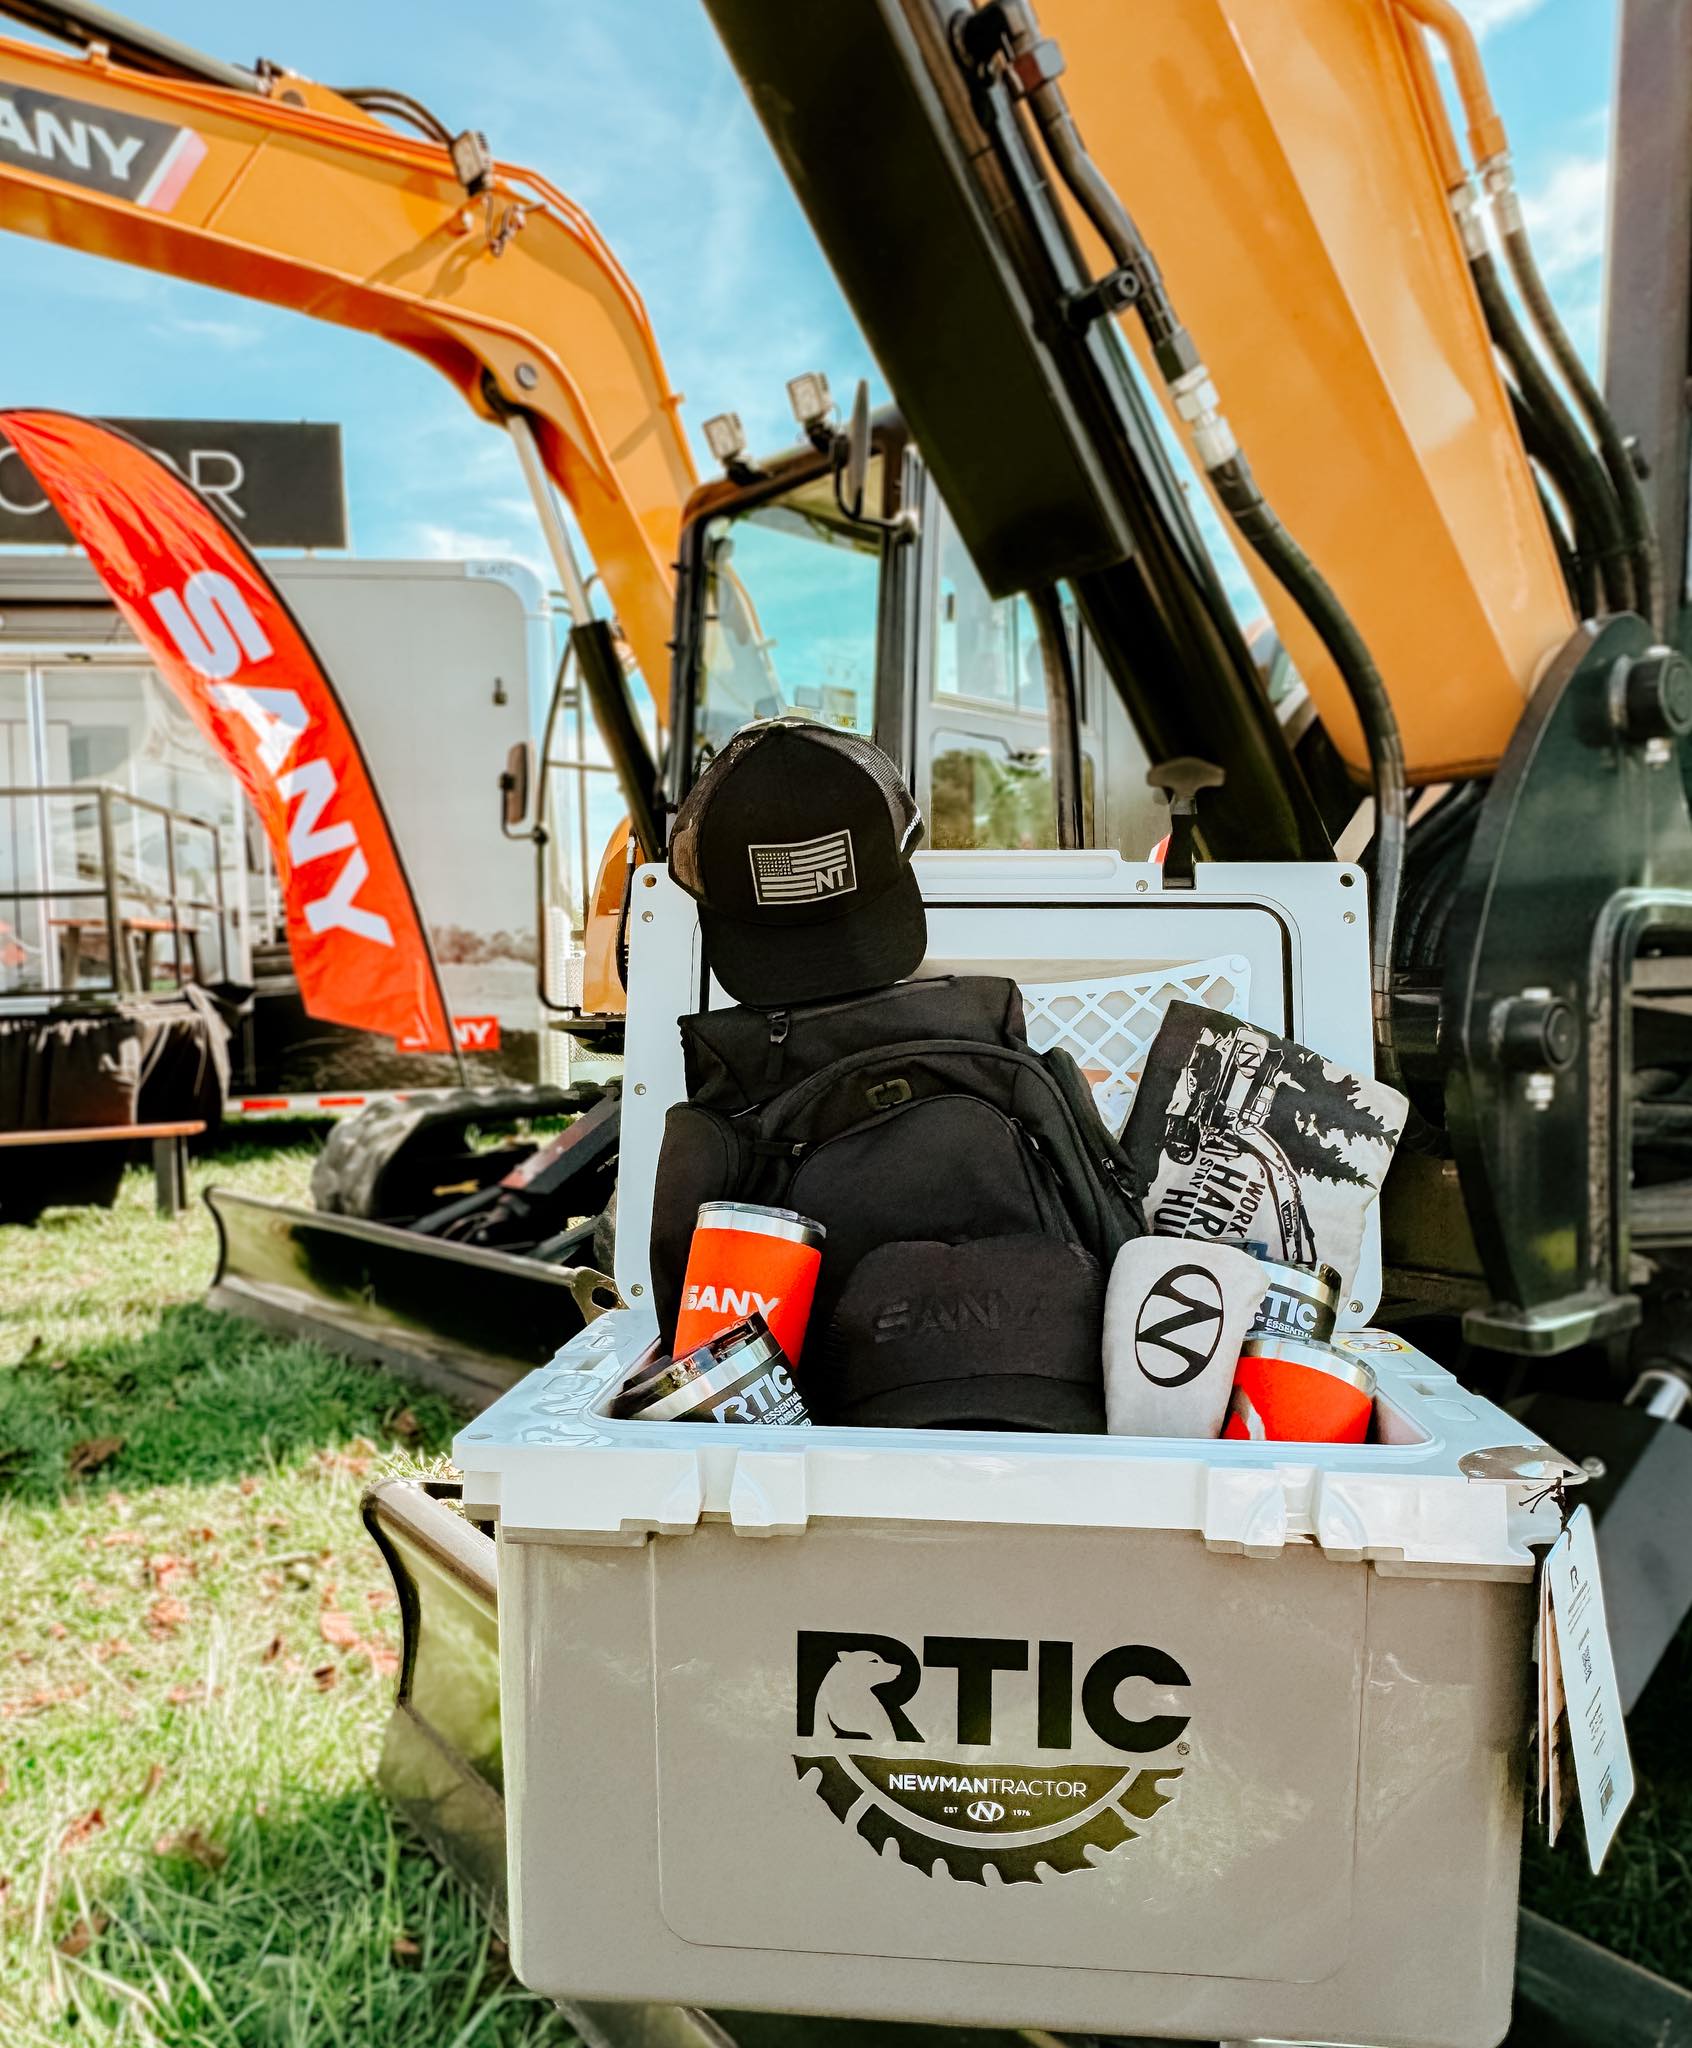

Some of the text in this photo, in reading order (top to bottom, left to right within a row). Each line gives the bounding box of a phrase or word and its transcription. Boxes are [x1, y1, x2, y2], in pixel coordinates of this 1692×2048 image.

[149, 579, 396, 949] SANY
[815, 863, 848, 893] NT
[1189, 1156, 1214, 1191] STAY
[1153, 1188, 1199, 1239] HU
[1183, 1163, 1249, 1240] HAR
[1226, 1180, 1267, 1239] WORK
[686, 1284, 780, 1321] SANY
[1258, 1289, 1318, 1331] TIC
[711, 1364, 793, 1424] RTIC
[797, 1630, 1192, 1753] RTIC
